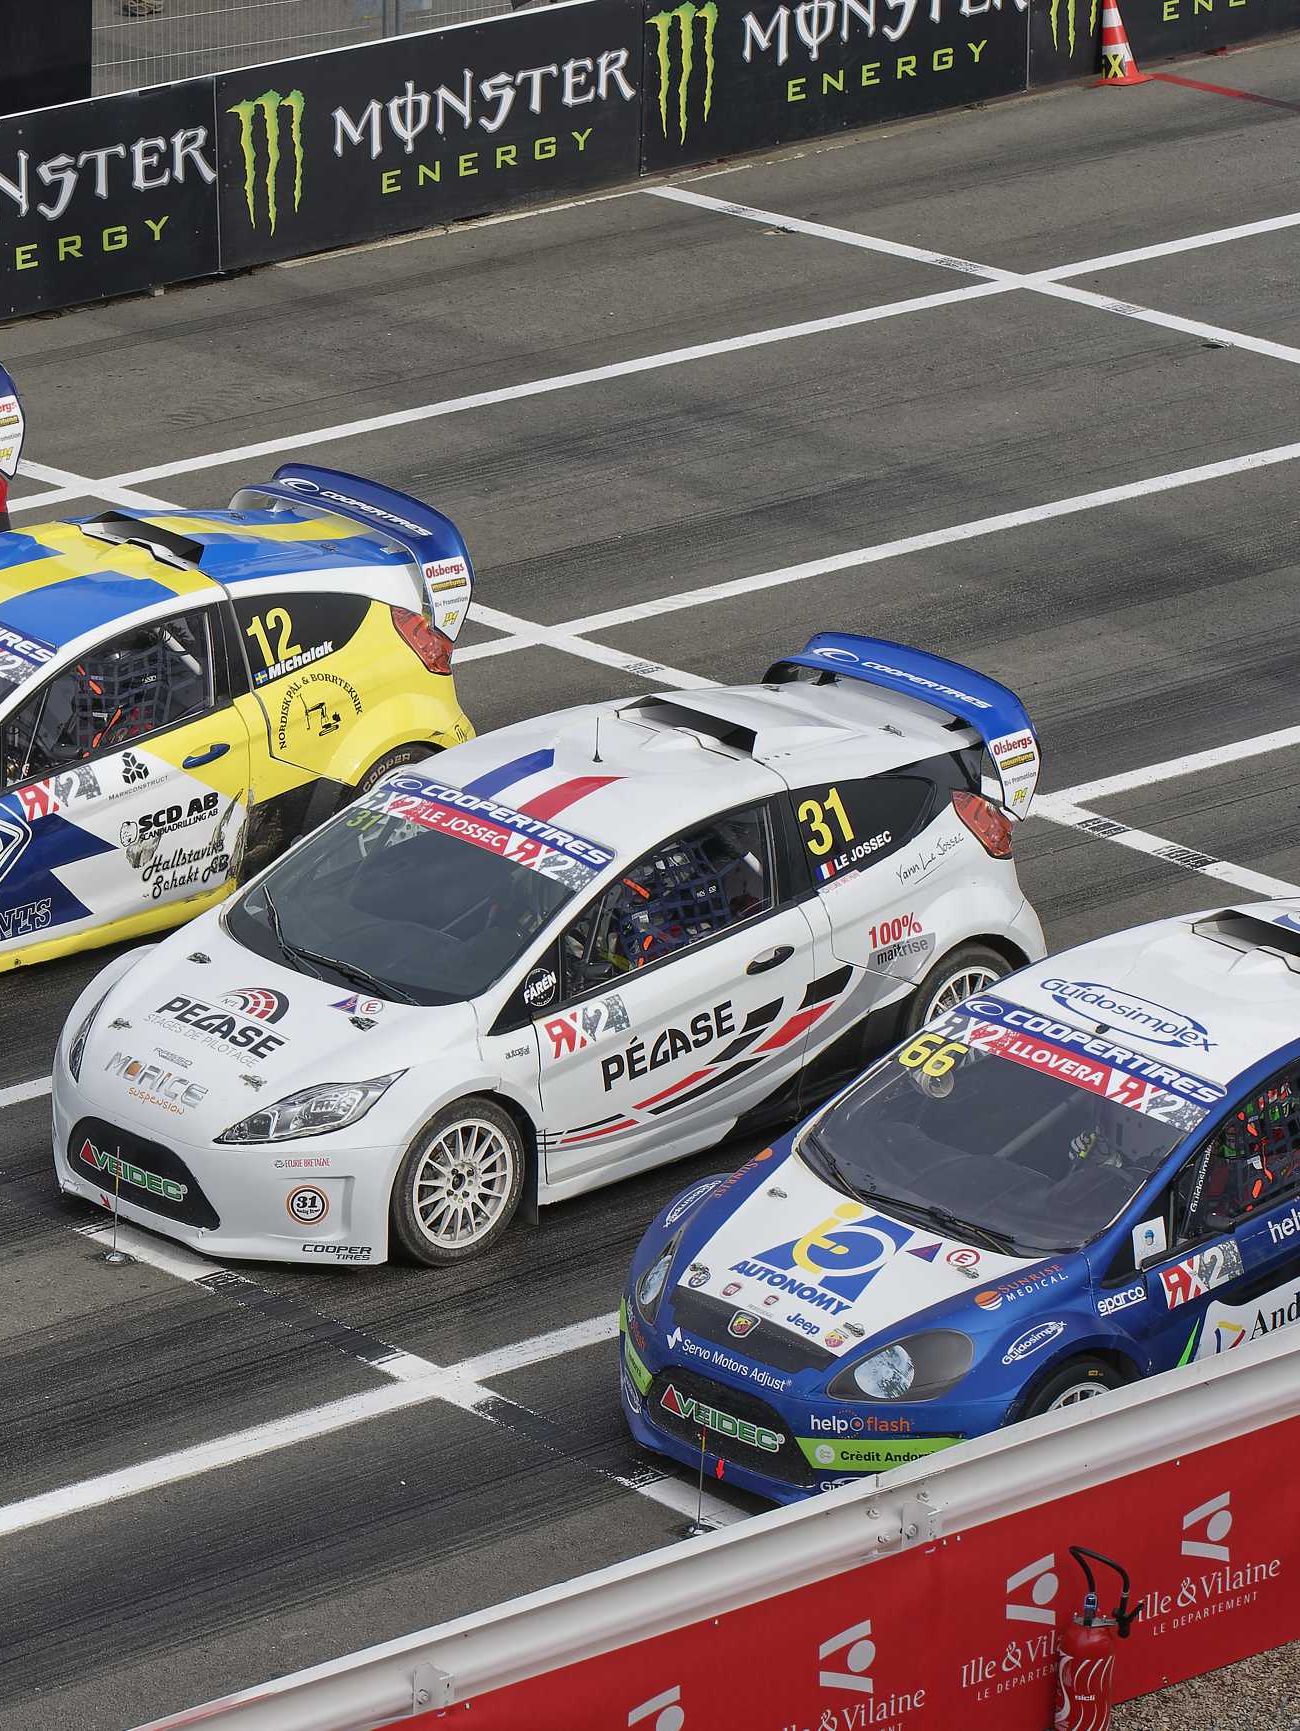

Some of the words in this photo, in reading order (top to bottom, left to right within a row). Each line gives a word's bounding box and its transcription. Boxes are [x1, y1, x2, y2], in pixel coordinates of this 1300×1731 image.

[787, 39, 988, 102] ENERGY
[331, 47, 637, 160] MONSTER
[381, 127, 595, 195] ENERGY
[320, 490, 433, 537] COOPERTIRES
[425, 563, 465, 579] Olsbergs
[246, 607, 303, 666] 12
[267, 640, 334, 680] Michalak
[311, 673, 364, 715] BORRTEKNIK
[861, 661, 993, 709] COOPERTIRES
[993, 735, 1033, 756] Olsbergs
[362, 752, 411, 792] COOPER
[138, 805, 183, 834] SCD
[187, 792, 219, 817] AB
[207, 808, 219, 820] AB
[346, 809, 382, 830] 31
[420, 784, 614, 865] COOPERTIRES
[421, 808, 439, 823] LE
[441, 815, 508, 848] JOSSEC
[798, 787, 855, 857] 31
[142, 838, 225, 881] Hallstaviks
[835, 855, 849, 872] LE
[850, 830, 893, 862] JOSSEC
[152, 865, 199, 899] Schakt
[202, 854, 229, 884] AB
[896, 863, 920, 885] Yann
[868, 912, 923, 950] 100%
[876, 937, 929, 966] maîtrise
[524, 969, 557, 1004] FÄRÉN
[155, 996, 286, 1059] PEGASE
[1040, 978, 1219, 1052] Guidosimplex
[143, 1013, 186, 1034] STAGES
[183, 1028, 200, 1041] DE
[200, 1036, 260, 1068] PILOTAGE
[601, 1000, 736, 1092] PÉGASE
[898, 1033, 969, 1077] 66
[1002, 1010, 1221, 1104] COOPERTIRES
[1009, 1041, 1104, 1086] LLOVERA
[92, 1148, 184, 1202] VEIDEC
[296, 1195, 318, 1208] 31
[301, 1244, 373, 1254] COOPER
[335, 1253, 371, 1261] TIRES
[728, 1260, 853, 1316] AUTONOMY
[999, 1263, 1064, 1293] SUNRISE
[1098, 1286, 1145, 1314] sparco
[786, 1313, 821, 1336] Jeep
[1002, 1321, 1067, 1365] Guidosimplex
[682, 1338, 711, 1361] Servo
[712, 1351, 749, 1377] Motors
[749, 1367, 786, 1392] Adjust
[677, 1390, 782, 1452] VEIDEC
[810, 1414, 848, 1434] help
[866, 1415, 911, 1432] flash
[840, 1451, 881, 1462] Crèdit
[1177, 1577, 1198, 1608] &
[1200, 1559, 1282, 1600] Vilaine
[1153, 1624, 1167, 1636] LE
[1173, 1591, 1260, 1629] DEPARTEMENT
[961, 1657, 997, 1688] Ille
[1002, 1641, 1022, 1673] &
[842, 1688, 926, 1731] Vilaine
[977, 1687, 990, 1701] LE
